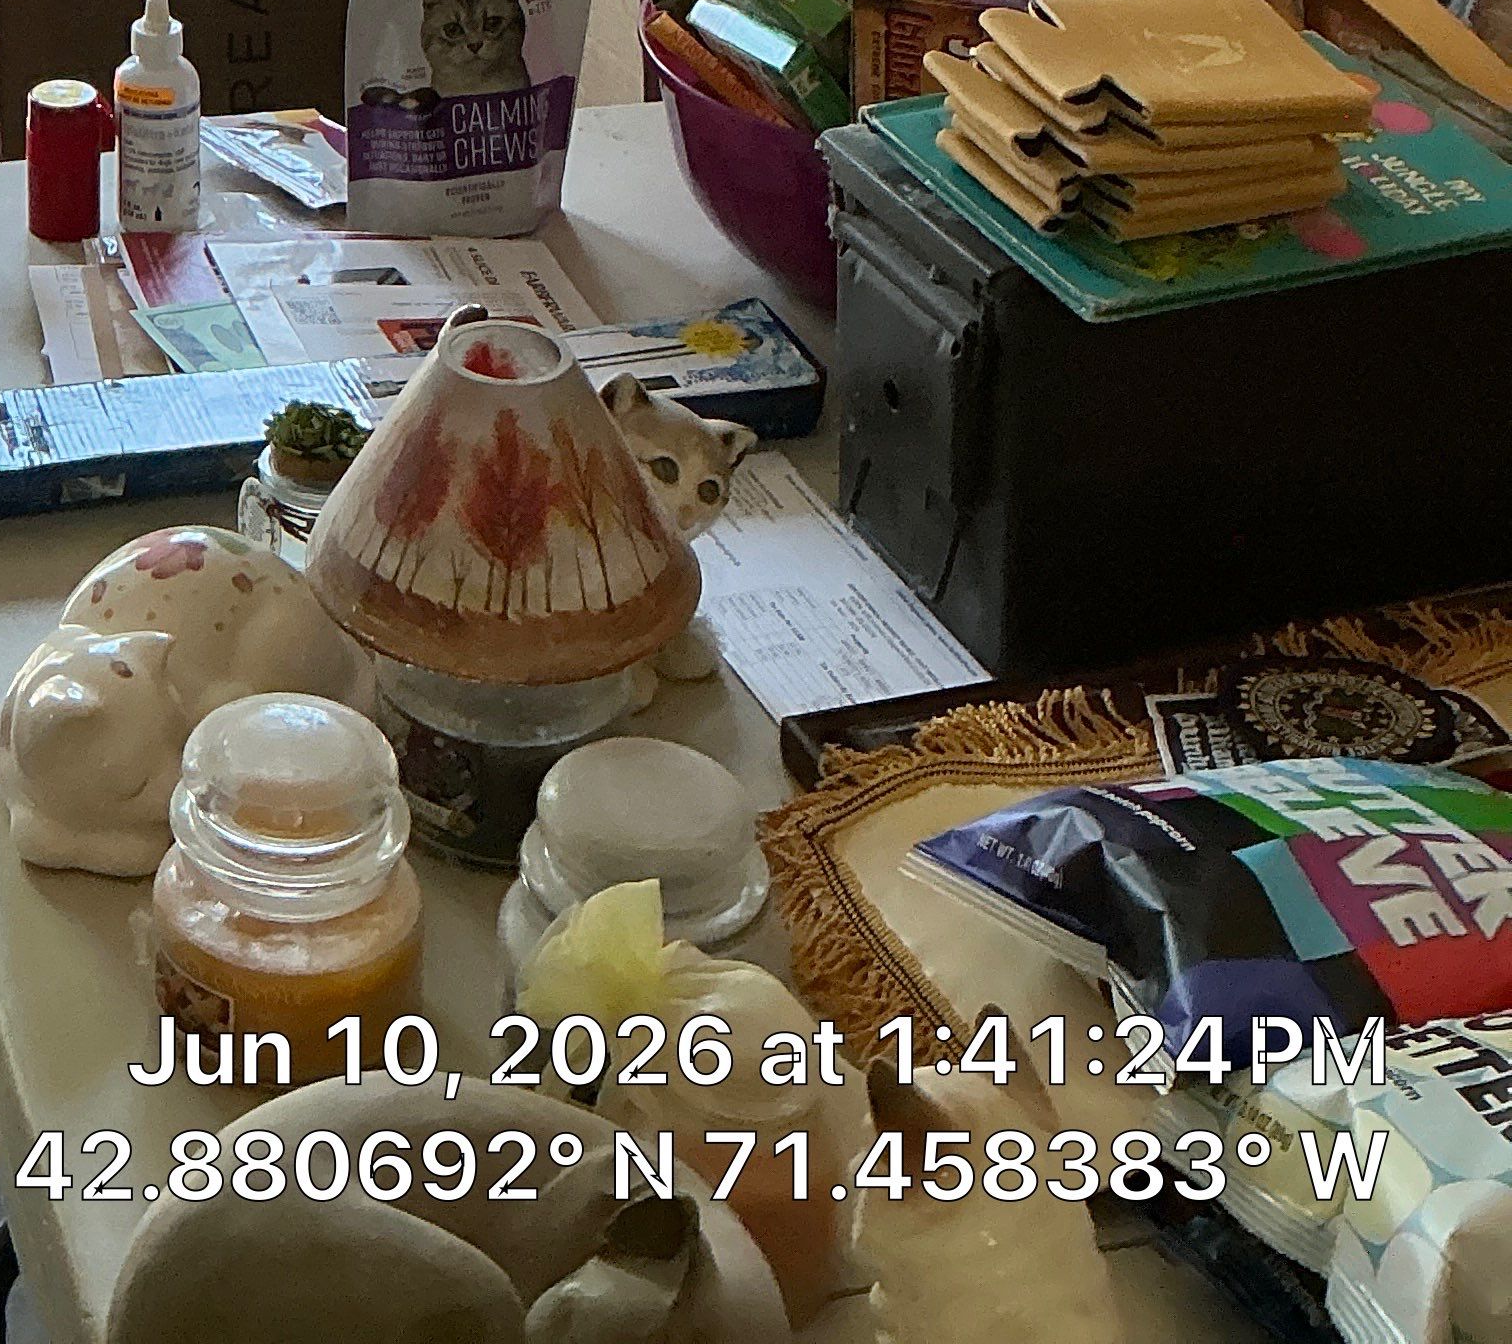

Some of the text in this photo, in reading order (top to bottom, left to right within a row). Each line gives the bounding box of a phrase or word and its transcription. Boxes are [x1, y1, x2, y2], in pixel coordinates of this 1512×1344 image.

[451, 90, 550, 135] CALMIN
[453, 124, 539, 170] CHEWS
[1370, 152, 1460, 213] JUNGLE
